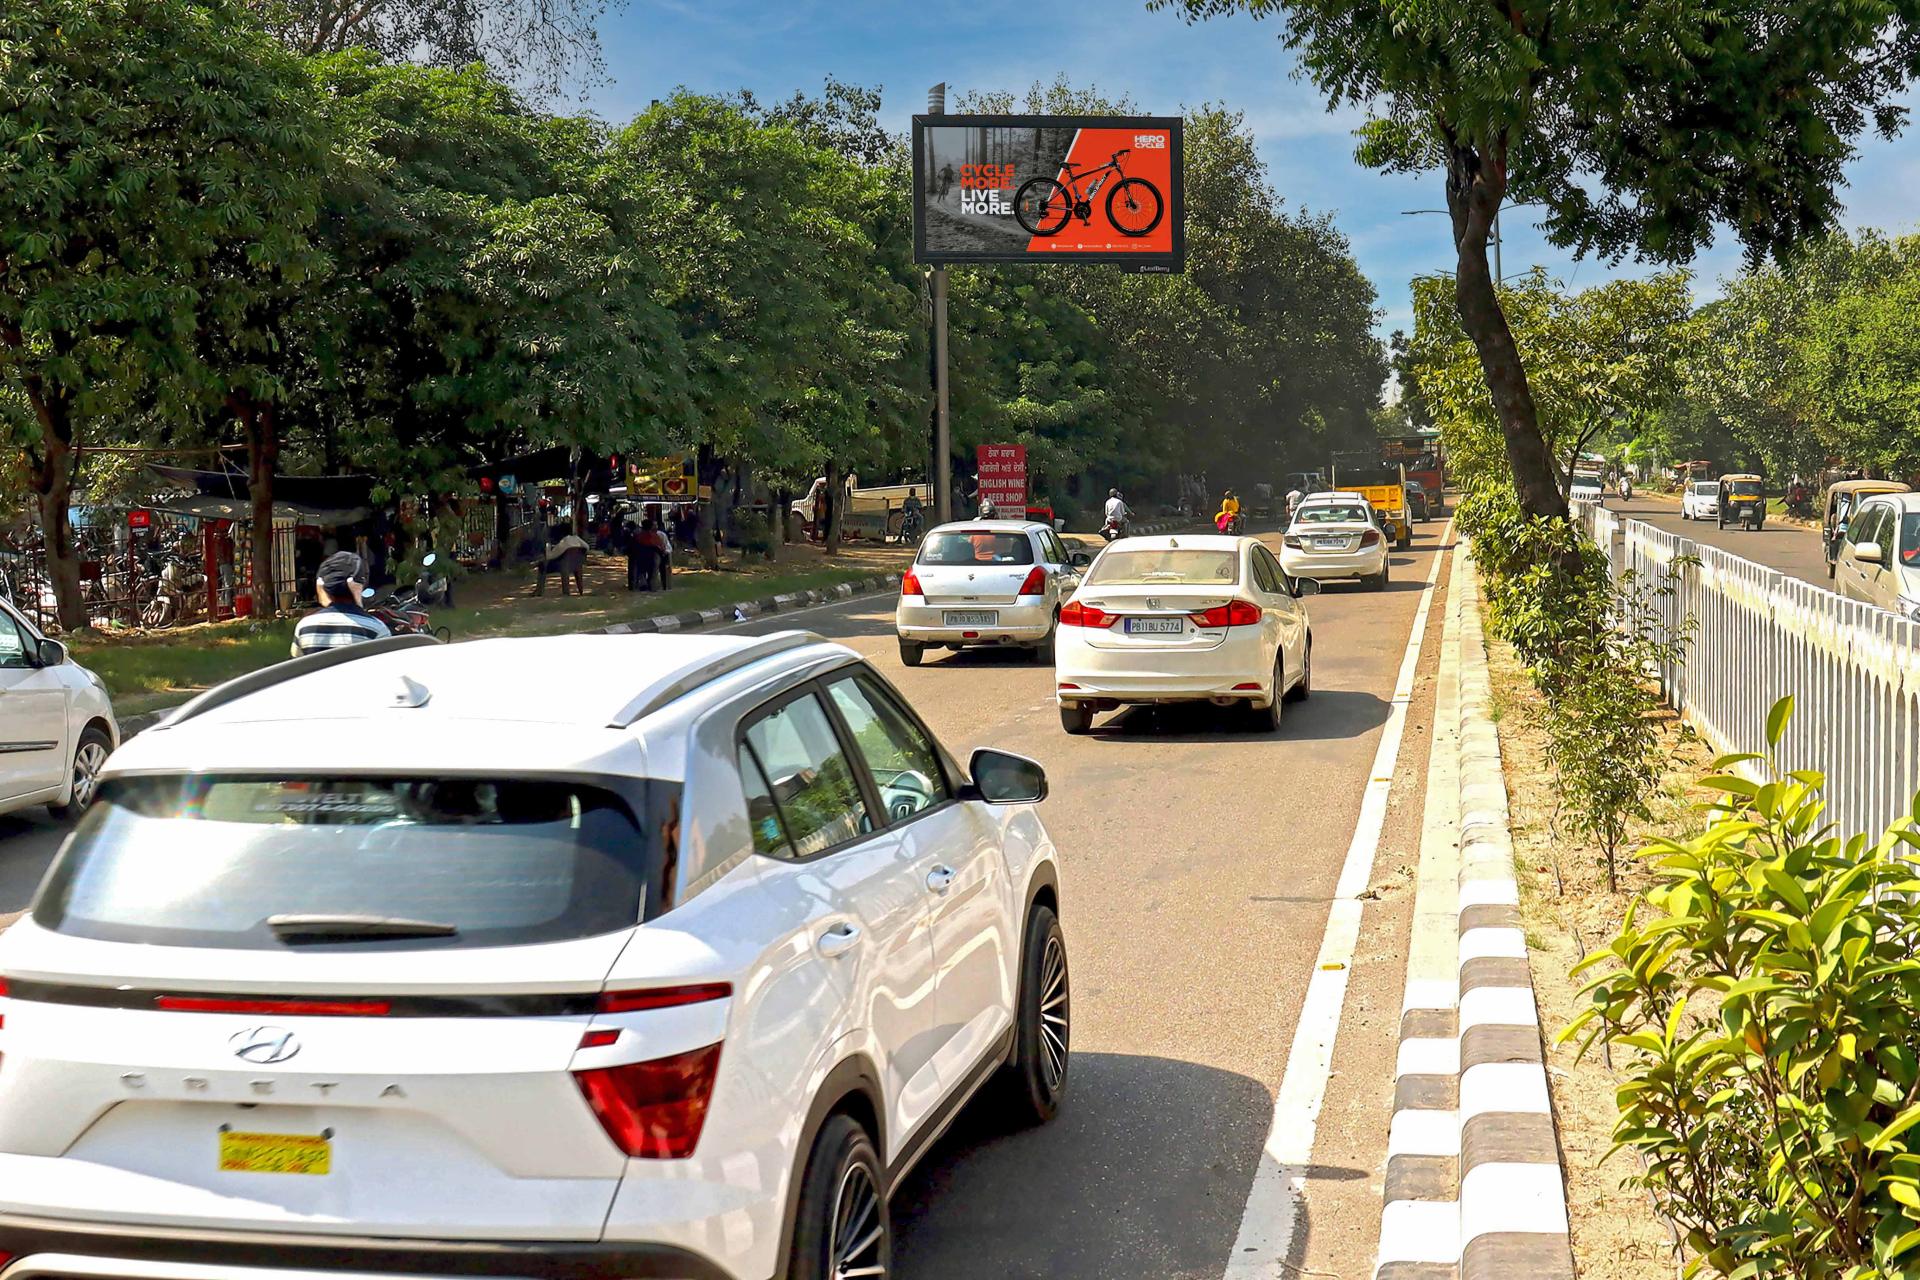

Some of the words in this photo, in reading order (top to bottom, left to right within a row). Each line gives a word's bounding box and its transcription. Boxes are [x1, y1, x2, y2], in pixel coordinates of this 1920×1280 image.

[1135, 135, 1165, 143] HERO
[960, 163, 1015, 177] CYCLE
[961, 177, 1016, 190] MORE.
[961, 189, 1000, 202] LIVE
[961, 201, 1015, 215] MORE.
[980, 479, 1007, 489] ENGLISH
[1008, 479, 1025, 489] WINE
[1006, 493, 1023, 503] SHOP
[1160, 622, 1180, 632] 5774
[119, 1070, 408, 1099] CRETA
